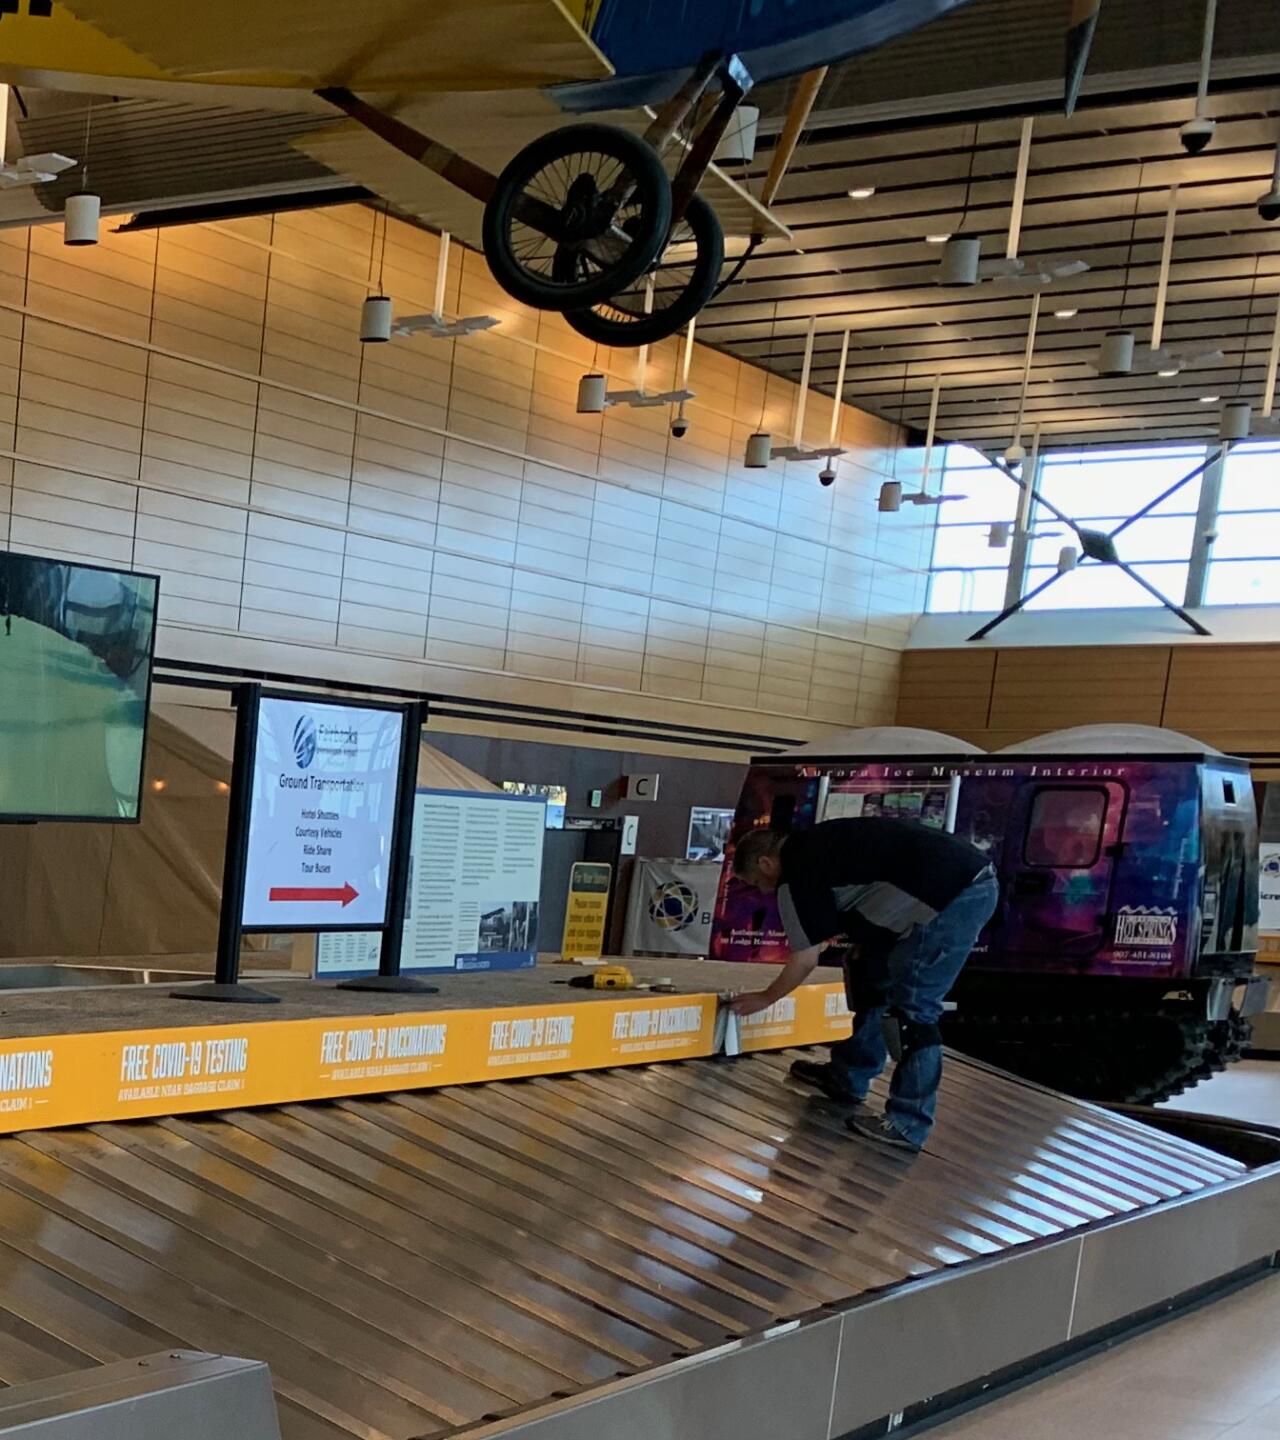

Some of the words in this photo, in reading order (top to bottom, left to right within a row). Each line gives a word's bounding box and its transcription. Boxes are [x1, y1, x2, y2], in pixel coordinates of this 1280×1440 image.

[797, 766, 869, 778] Aurora
[883, 767, 915, 777] Ice
[930, 766, 1016, 777] Museum
[1030, 765, 1127, 777] Interior
[280, 773, 309, 789] Ground
[310, 775, 364, 793] Transportation
[635, 778, 649, 796] C
[320, 827, 342, 839] Vehicles
[303, 844, 315, 855] Ride
[316, 844, 332, 856] Share
[301, 862, 314, 873] Tour
[315, 862, 331, 873] Buses
[321, 1031, 345, 1064] FREE
[121, 1045, 151, 1082] FREE
[152, 1041, 203, 1079] COVID-19
[205, 1038, 249, 1075] TESTING
[0, 1097, 27, 1113] CLAIM
